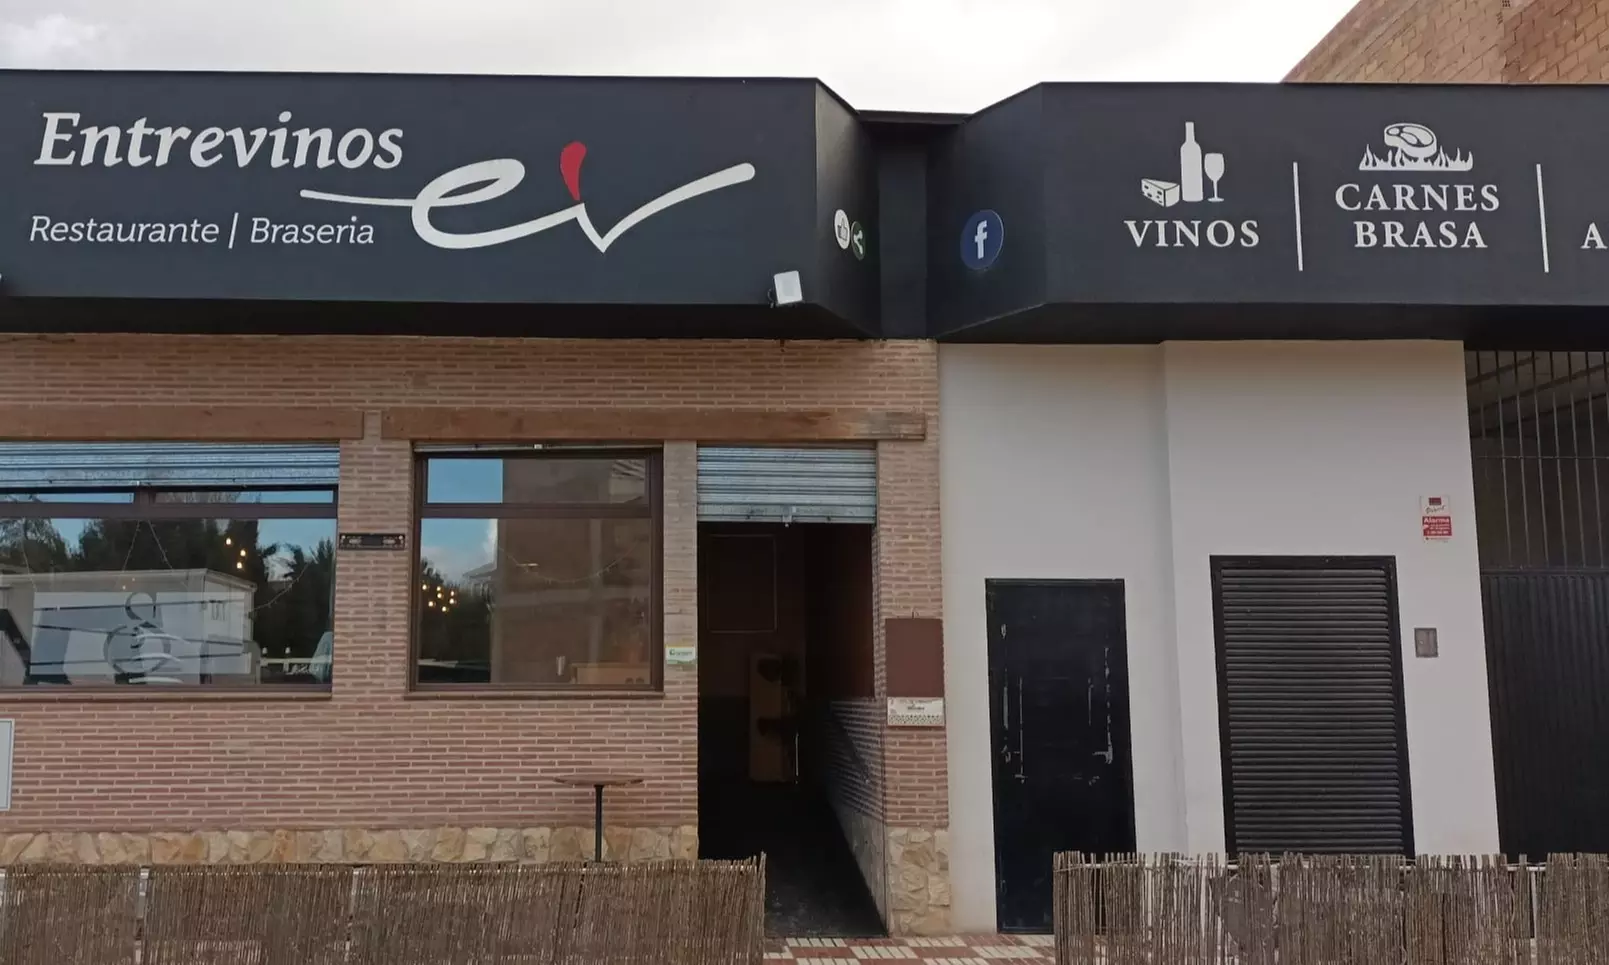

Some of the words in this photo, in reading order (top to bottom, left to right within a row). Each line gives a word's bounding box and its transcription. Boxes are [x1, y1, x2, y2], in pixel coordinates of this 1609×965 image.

[33, 110, 405, 169] Entrevinos
[1334, 183, 1501, 213] CARNES
[29, 215, 220, 244] Restaurante
[250, 214, 375, 245] Braseria
[1123, 219, 1261, 249] VINOS
[1353, 220, 1489, 250] BRASA
